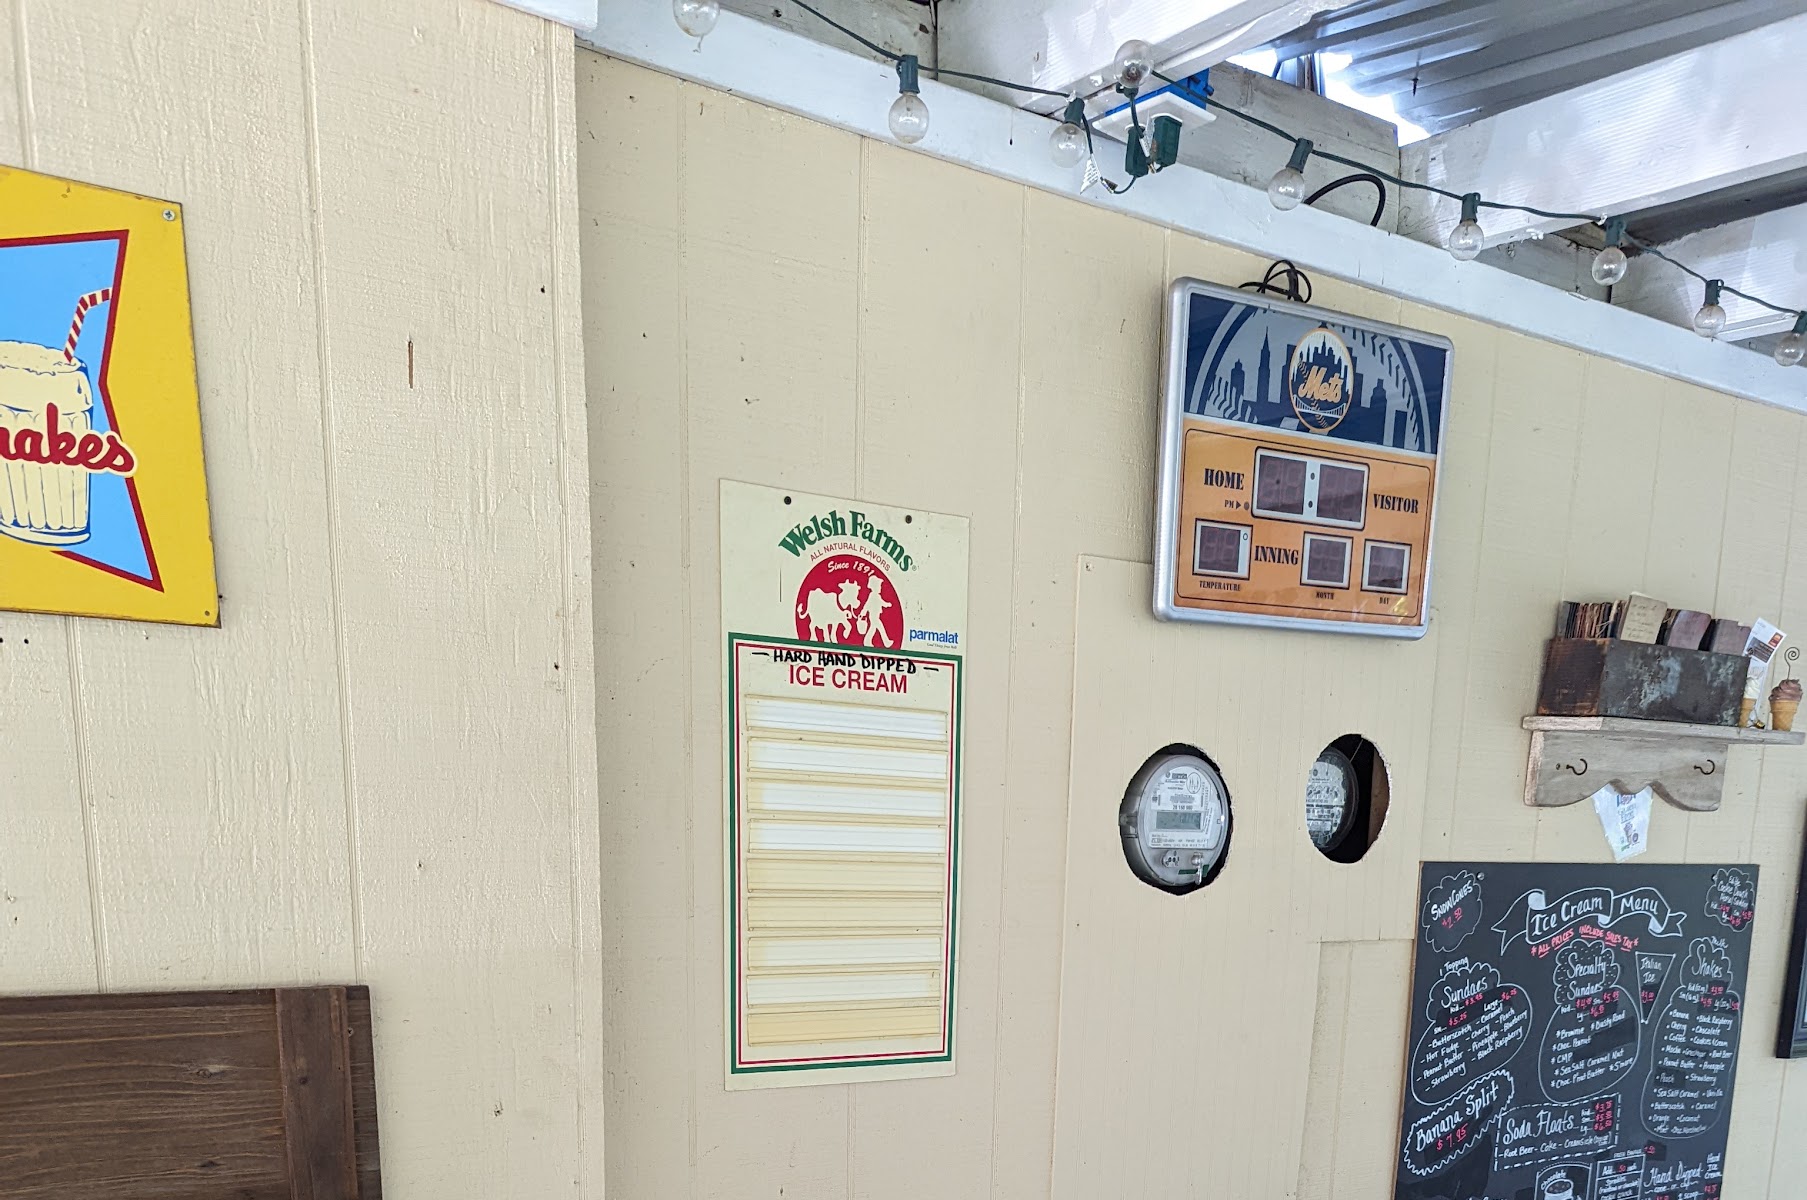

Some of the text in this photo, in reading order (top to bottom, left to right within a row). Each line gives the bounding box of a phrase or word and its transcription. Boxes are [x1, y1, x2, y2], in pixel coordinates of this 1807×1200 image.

[1298, 367, 1343, 402] Mets
[1203, 467, 1244, 491] HOME
[1224, 500, 1235, 509] PM
[1373, 494, 1419, 515] VISITOR
[778, 510, 914, 572] Welsh Farms
[809, 542, 891, 572] ALL NATURAL FLAVORS
[1254, 545, 1299, 566] INNING
[827, 560, 875, 577] Since 1891
[1199, 581, 1241, 592] TEMPERATURE
[1316, 591, 1334, 600] MONTH
[909, 629, 959, 645] parmalat
[773, 649, 917, 674] HARD HAND DIPPED
[789, 664, 908, 694] ICE CREAM
[1530, 896, 1658, 936] Ice Cream Menu
[1538, 944, 1551, 956] ALL
[1551, 928, 1575, 947] PRICES
[1579, 924, 1604, 937] INCLUDE
[1444, 957, 1469, 971] Topping
[1567, 952, 1606, 985] Specialty
[1640, 957, 1661, 970] Italian
[1691, 944, 1723, 978] Shakes
[1643, 972, 1656, 983] Ice
[1441, 977, 1488, 1008] Sundaes
[1567, 980, 1603, 1000] Sundaes
[1499, 1008, 1515, 1023] Peach
[1432, 1025, 1471, 1048] Butterscotch
[1695, 1025, 1721, 1035] Chocolate
[1423, 1010, 1527, 1079] Peanut Butter Pineapple Blueberry
[1431, 1026, 1523, 1087] Strawberry Black Raspberry
[1587, 1053, 1610, 1067] Caramel
[1612, 1048, 1624, 1059] Nut
[1663, 1057, 1679, 1067] Peanut
[1586, 1067, 1605, 1079] Butter
[1689, 1073, 1717, 1086] Strawberry
[1416, 1080, 1499, 1152] Banana Split
[1503, 1110, 1574, 1144] Soda Floats
[1504, 1149, 1518, 1158] Root
[1519, 1146, 1534, 1156] Beer
[1540, 1140, 1557, 1152] Coke
[1644, 1161, 1701, 1187] Hand Dipped
